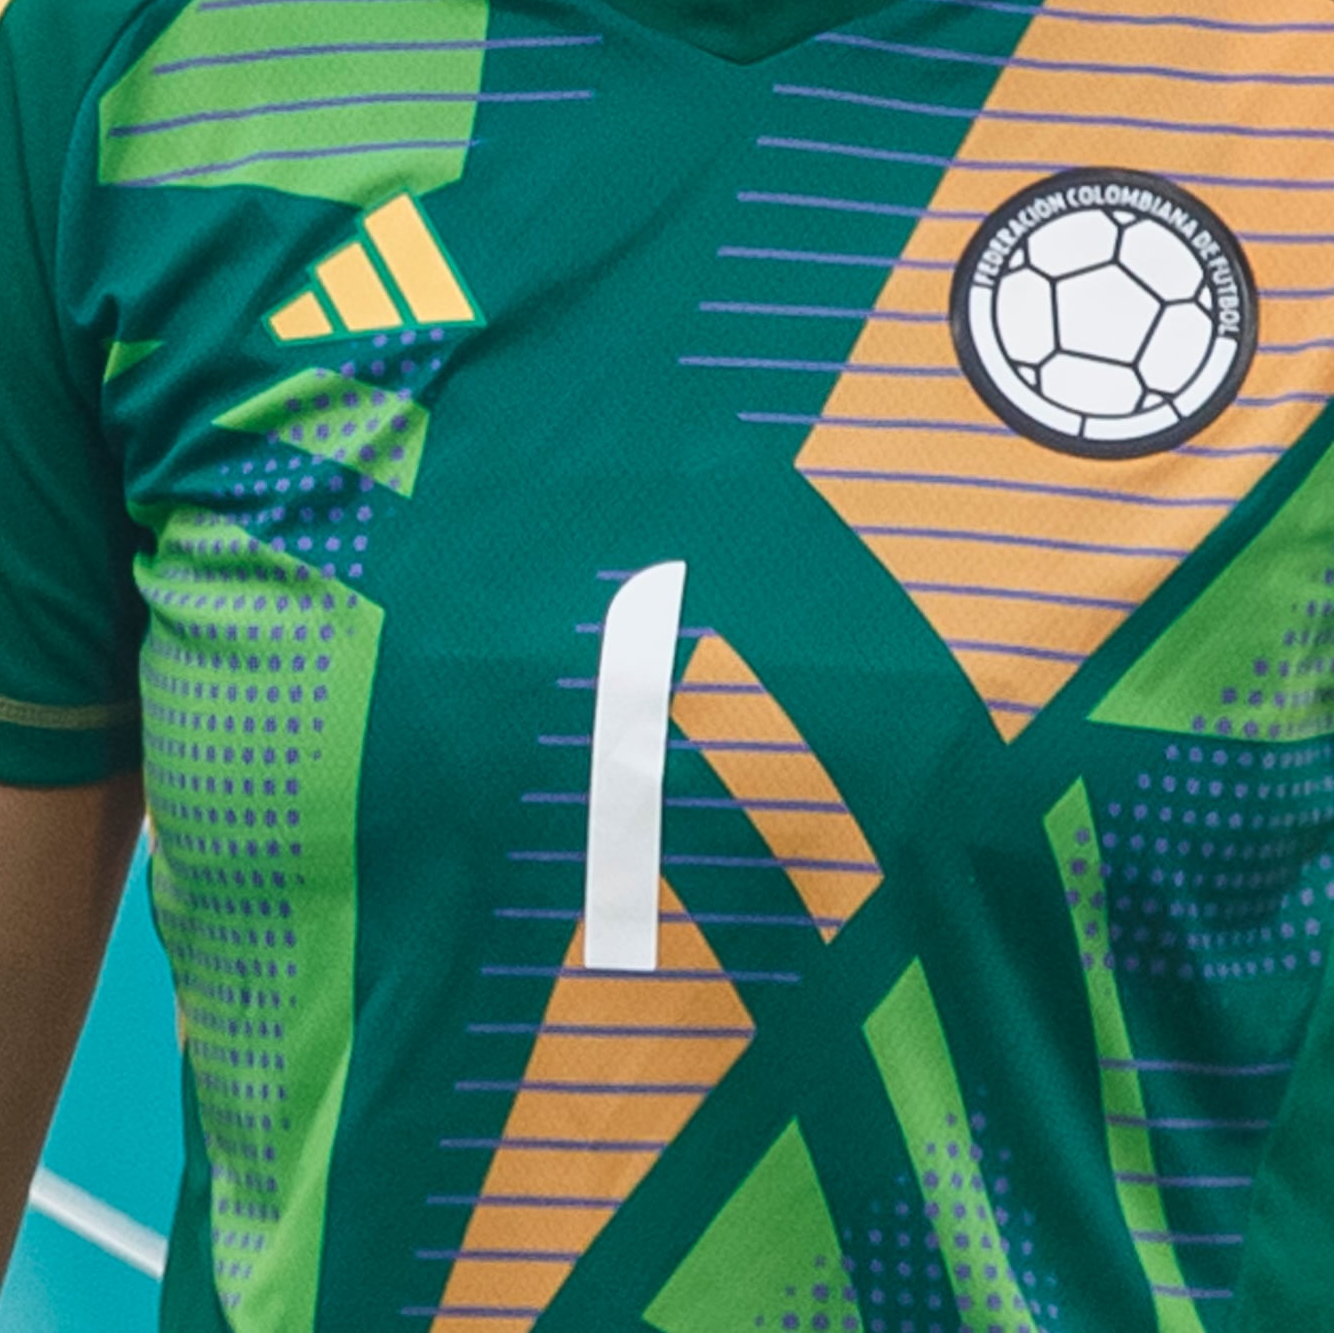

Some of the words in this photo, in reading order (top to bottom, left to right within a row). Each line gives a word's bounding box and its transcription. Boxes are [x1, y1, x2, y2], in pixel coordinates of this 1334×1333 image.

[1066, 183, 1199, 240] COLOMBIANA
[1190, 229, 1222, 261] DE
[584, 559, 687, 972] 1
